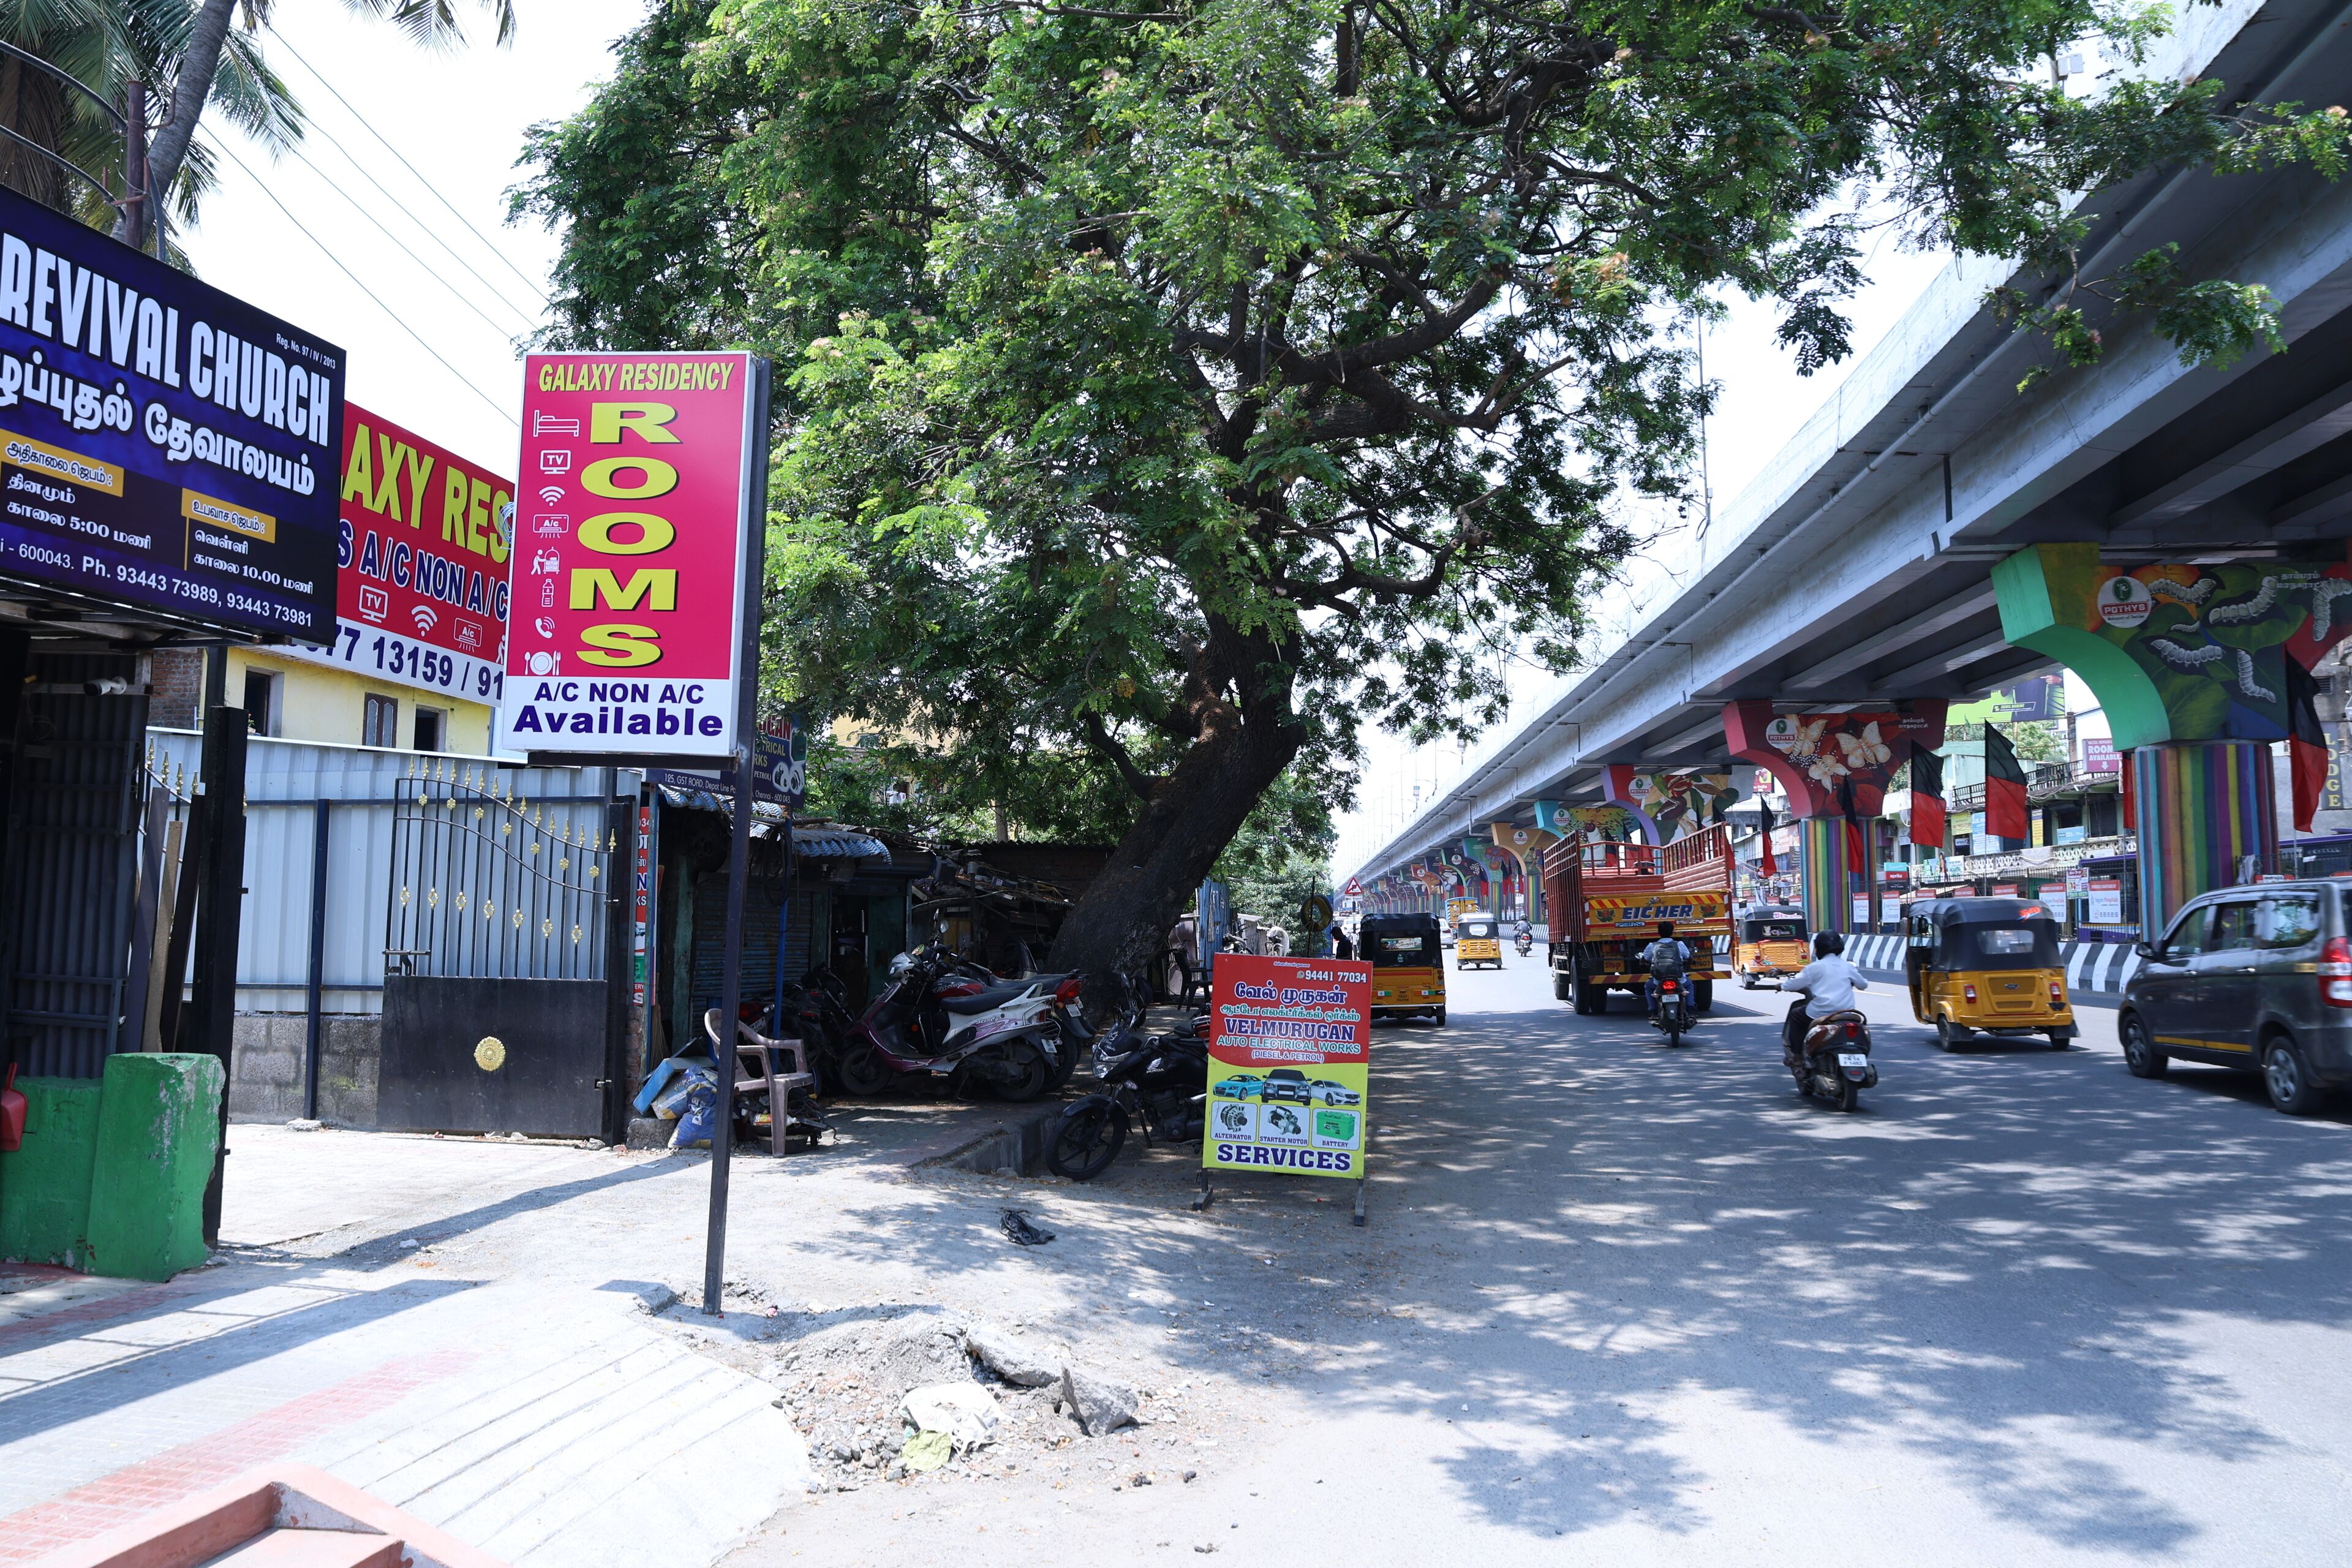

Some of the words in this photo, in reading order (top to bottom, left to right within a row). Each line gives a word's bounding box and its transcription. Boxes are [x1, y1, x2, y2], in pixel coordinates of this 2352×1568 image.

[0, 233, 180, 388] REVIVAL
[189, 321, 330, 447] CHURCH
[276, 333, 290, 350] Reg.
[291, 339, 301, 353] No.
[539, 364, 617, 391] GALAXY
[619, 363, 734, 391] RESIDENCY
[6, 442, 69, 472] அதிகாலை
[145, 402, 315, 496] தேவாலயம்
[547, 454, 564, 465] TV
[7, 473, 75, 503] தினமும்
[341, 423, 435, 529] AXY
[192, 500, 230, 522] உபவாச
[7, 501, 66, 526] காலை
[70, 516, 110, 538] 5:00
[113, 530, 151, 550] மணி
[195, 530, 248, 554] வெள்ளி
[19, 543, 74, 569] 600043.
[83, 556, 111, 578] Ph.
[117, 565, 167, 592] 93443
[172, 578, 222, 608] 73989,
[227, 592, 270, 616] 93443
[274, 605, 311, 627] 73981
[194, 553, 239, 574] காலை
[243, 565, 280, 585] 10.00
[284, 578, 313, 594] மணி
[359, 530, 411, 587] A/C
[415, 549, 465, 606] NON
[466, 571, 508, 622] A/C
[366, 594, 382, 609] TV
[2104, 604, 2145, 613] POTHYS
[372, 636, 453, 687] 13159
[534, 682, 578, 701] A/C
[589, 683, 649, 703] NON
[659, 684, 704, 704] A/C
[513, 705, 722, 736] Available
[677, 775, 687, 785] GST
[705, 781, 720, 792] Depot
[720, 783, 729, 793] Line
[1622, 905, 1694, 921] EICHER
[1305, 970, 1333, 981] 94441
[1338, 972, 1366, 983] 77034
[1235, 981, 1278, 1000] வேல்
[1280, 985, 1347, 1005] முருகன்
[1220, 1004, 1259, 1017] ஆட்டோ
[1225, 1019, 1355, 1041] VELMURUGAN
[1217, 1035, 1247, 1047] AUTO
[1250, 1038, 1316, 1051] ELECTRICAL
[1319, 1042, 1360, 1054] WORKS
[1252, 1050, 1281, 1060] (DIESEL
[1291, 1054, 1324, 1063] PETROL)
[1218, 1144, 1351, 1170] SERVICES
